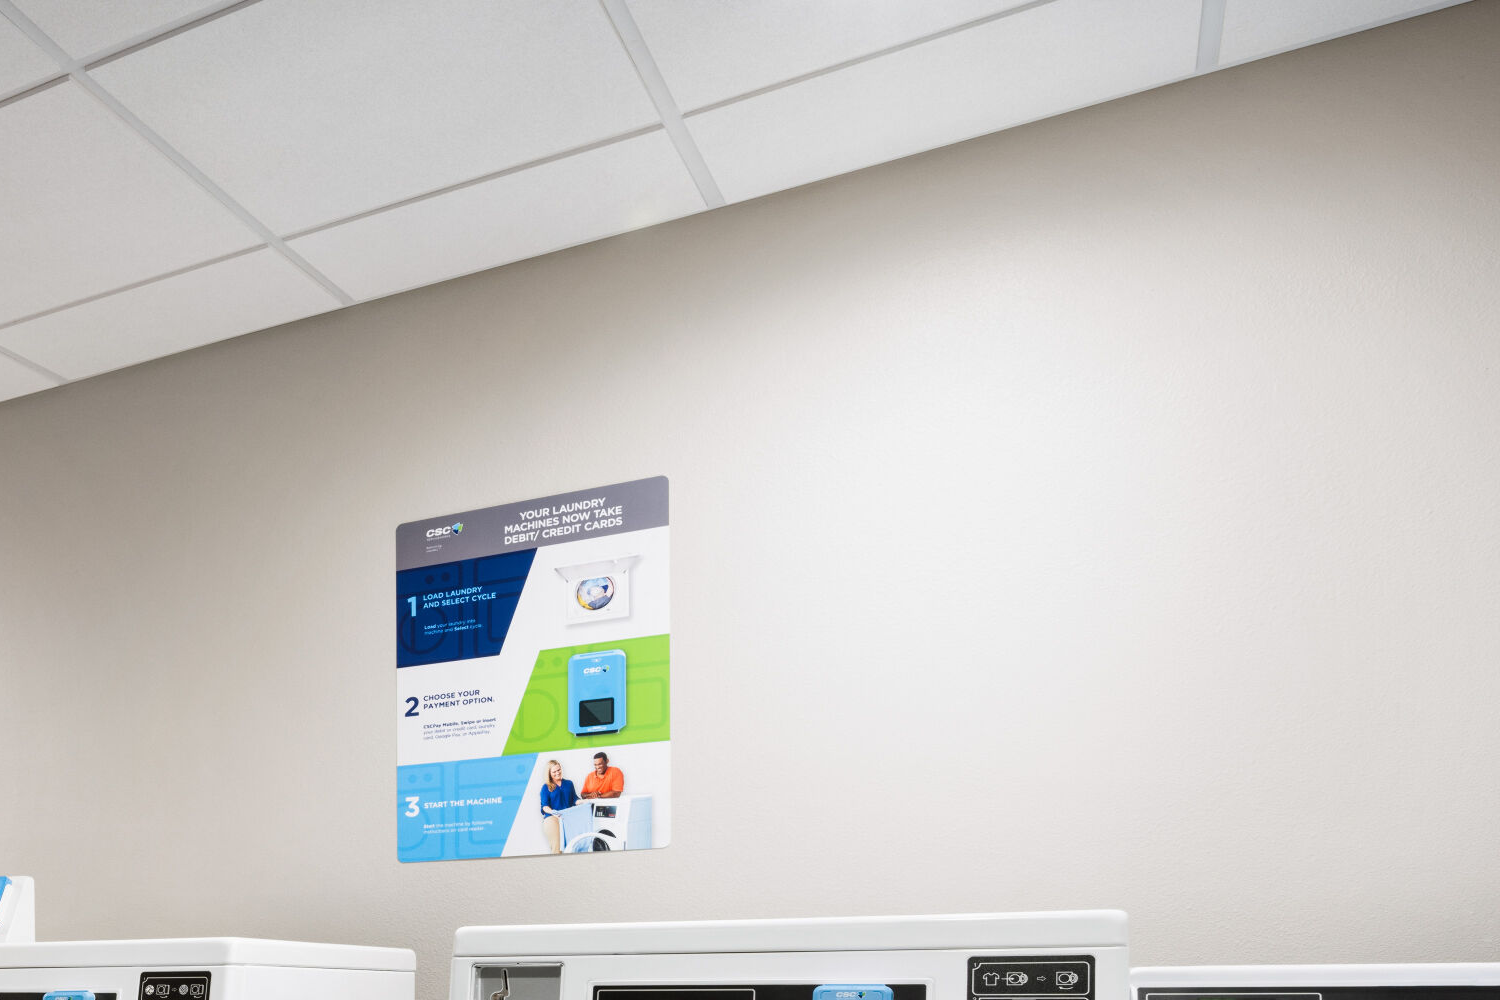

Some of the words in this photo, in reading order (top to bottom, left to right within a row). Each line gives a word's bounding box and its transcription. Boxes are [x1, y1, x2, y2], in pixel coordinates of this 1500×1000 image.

[519, 507, 550, 521] YOUR
[552, 497, 606, 515] LAUNDRY
[504, 517, 560, 534] MACHINES
[562, 511, 591, 524] NOW
[593, 505, 623, 519] TAKE
[426, 526, 452, 538] CSC
[504, 529, 540, 545] DEBIT/
[542, 523, 582, 538] CREDIT
[584, 517, 623, 531] CARDS
[423, 592, 444, 601] LOAD
[445, 586, 483, 598] LAUNDRY
[423, 600, 440, 609] AND
[441, 597, 470, 607] SELECT
[471, 592, 497, 602] CYCLE
[407, 595, 417, 617] 1
[423, 692, 456, 702] CHOOSE
[457, 689, 481, 698] YOUR
[423, 700, 460, 710] PAYMENT
[404, 696, 420, 717] 2
[404, 796, 420, 818] 3
[424, 801, 448, 809] START
[449, 799, 465, 807] THE
[466, 796, 502, 806] MACHINE
